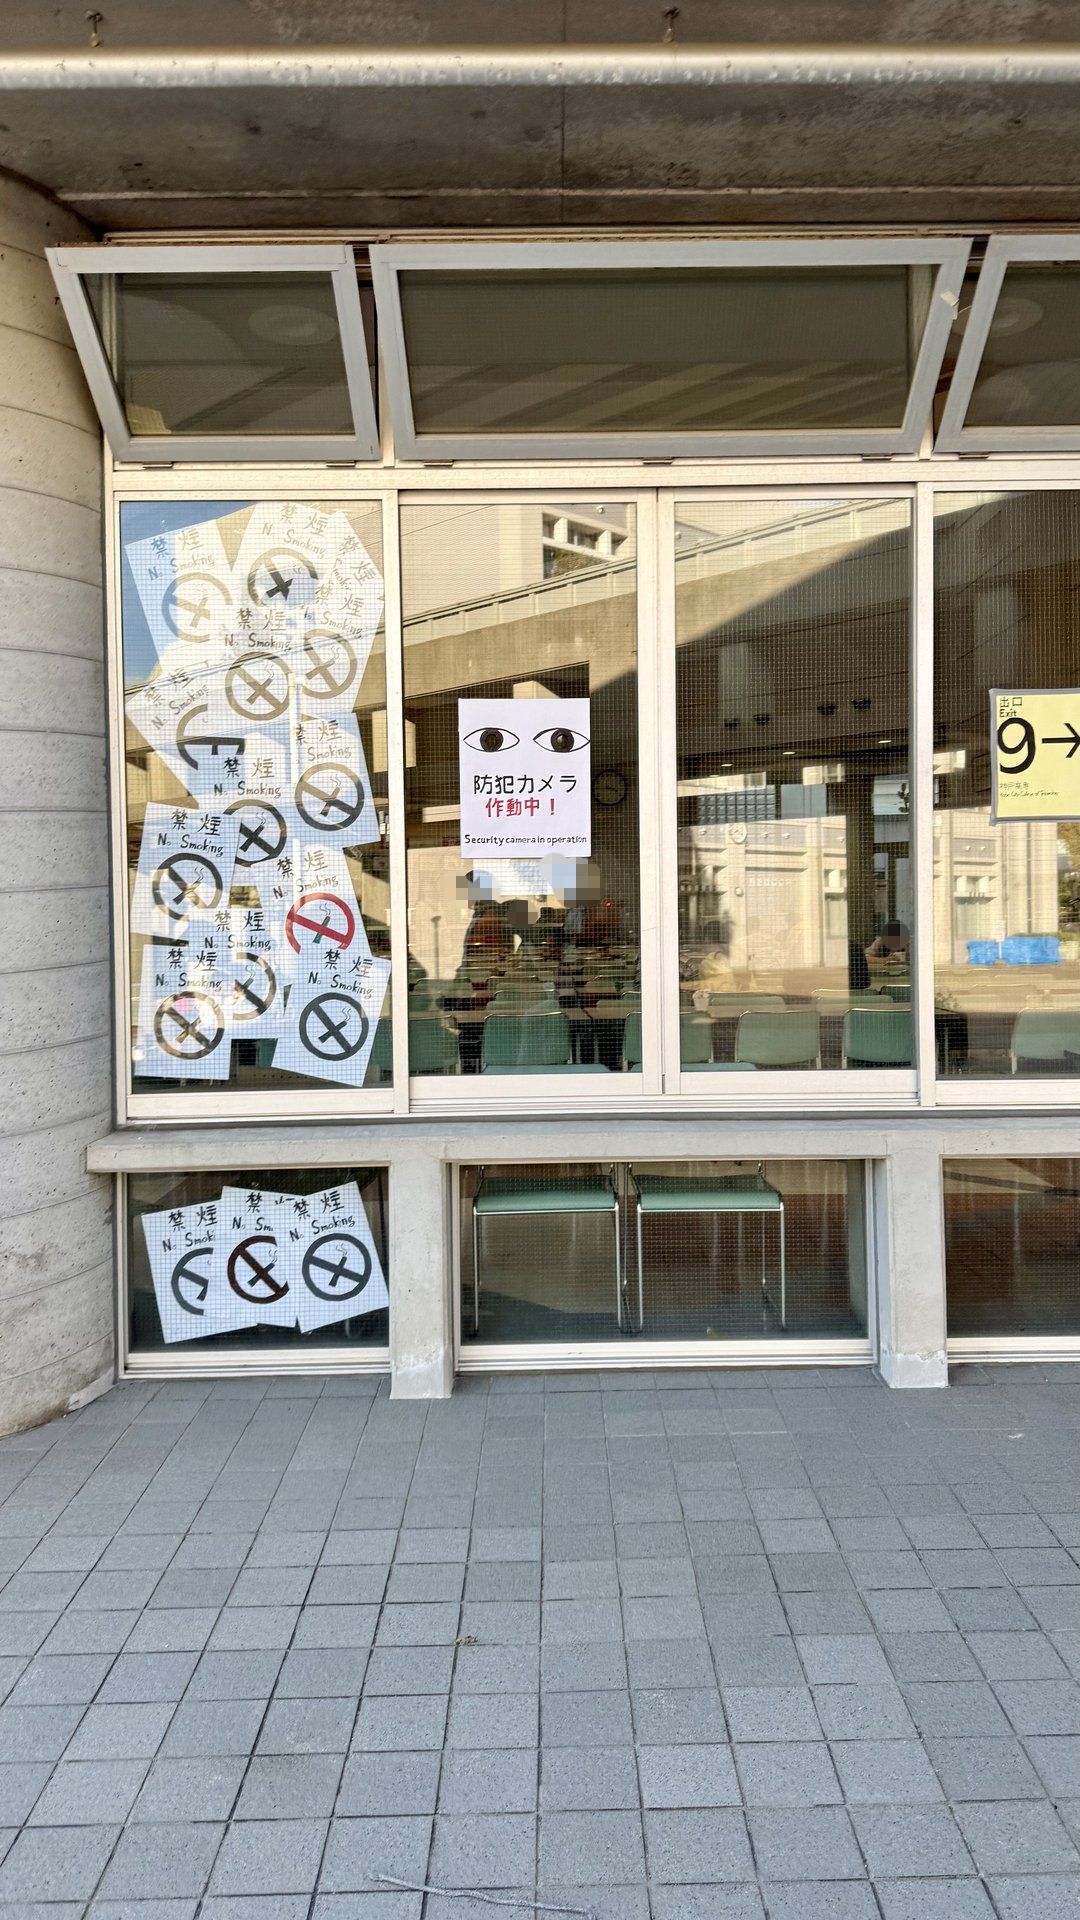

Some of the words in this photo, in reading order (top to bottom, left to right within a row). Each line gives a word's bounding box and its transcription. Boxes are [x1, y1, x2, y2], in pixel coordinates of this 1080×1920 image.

[151, 528, 204, 559] 禁煙
[284, 528, 326, 560] Smoking
[170, 552, 215, 574] Smoking
[236, 607, 287, 632] 禁煙
[321, 611, 363, 639] Smoking
[248, 633, 292, 651] Smoking
[168, 684, 209, 715] Smoking
[1000, 696, 1022, 708] 出口
[1000, 708, 1017, 717] Exit
[306, 745, 352, 762] Smoking
[997, 717, 1036, 774] 9
[223, 757, 275, 779] 禁煙
[237, 780, 282, 799] Smoking
[473, 774, 577, 794] 防犯カメラ
[485, 797, 555, 817] 作動中！
[170, 808, 222, 836] 禁煙
[180, 833, 224, 857] Smoking
[464, 834, 505, 846] Security
[505, 836, 536, 844] camera
[546, 836, 587, 846] operation
[277, 849, 328, 879] 禁煙
[296, 874, 339, 893] Smoking
[215, 910, 265, 932] 禁煙
[227, 934, 272, 951] Smoking
[167, 948, 219, 972] 禁煙
[324, 948, 374, 978] 禁煙
[178, 972, 223, 992] Smoking
[330, 974, 373, 999] Smoking
[293, 1190, 345, 1220] 禁煙
[168, 1204, 218, 1232] 禁煙
[311, 1215, 356, 1235] Smoking
[184, 1230, 216, 1247] Smoki
